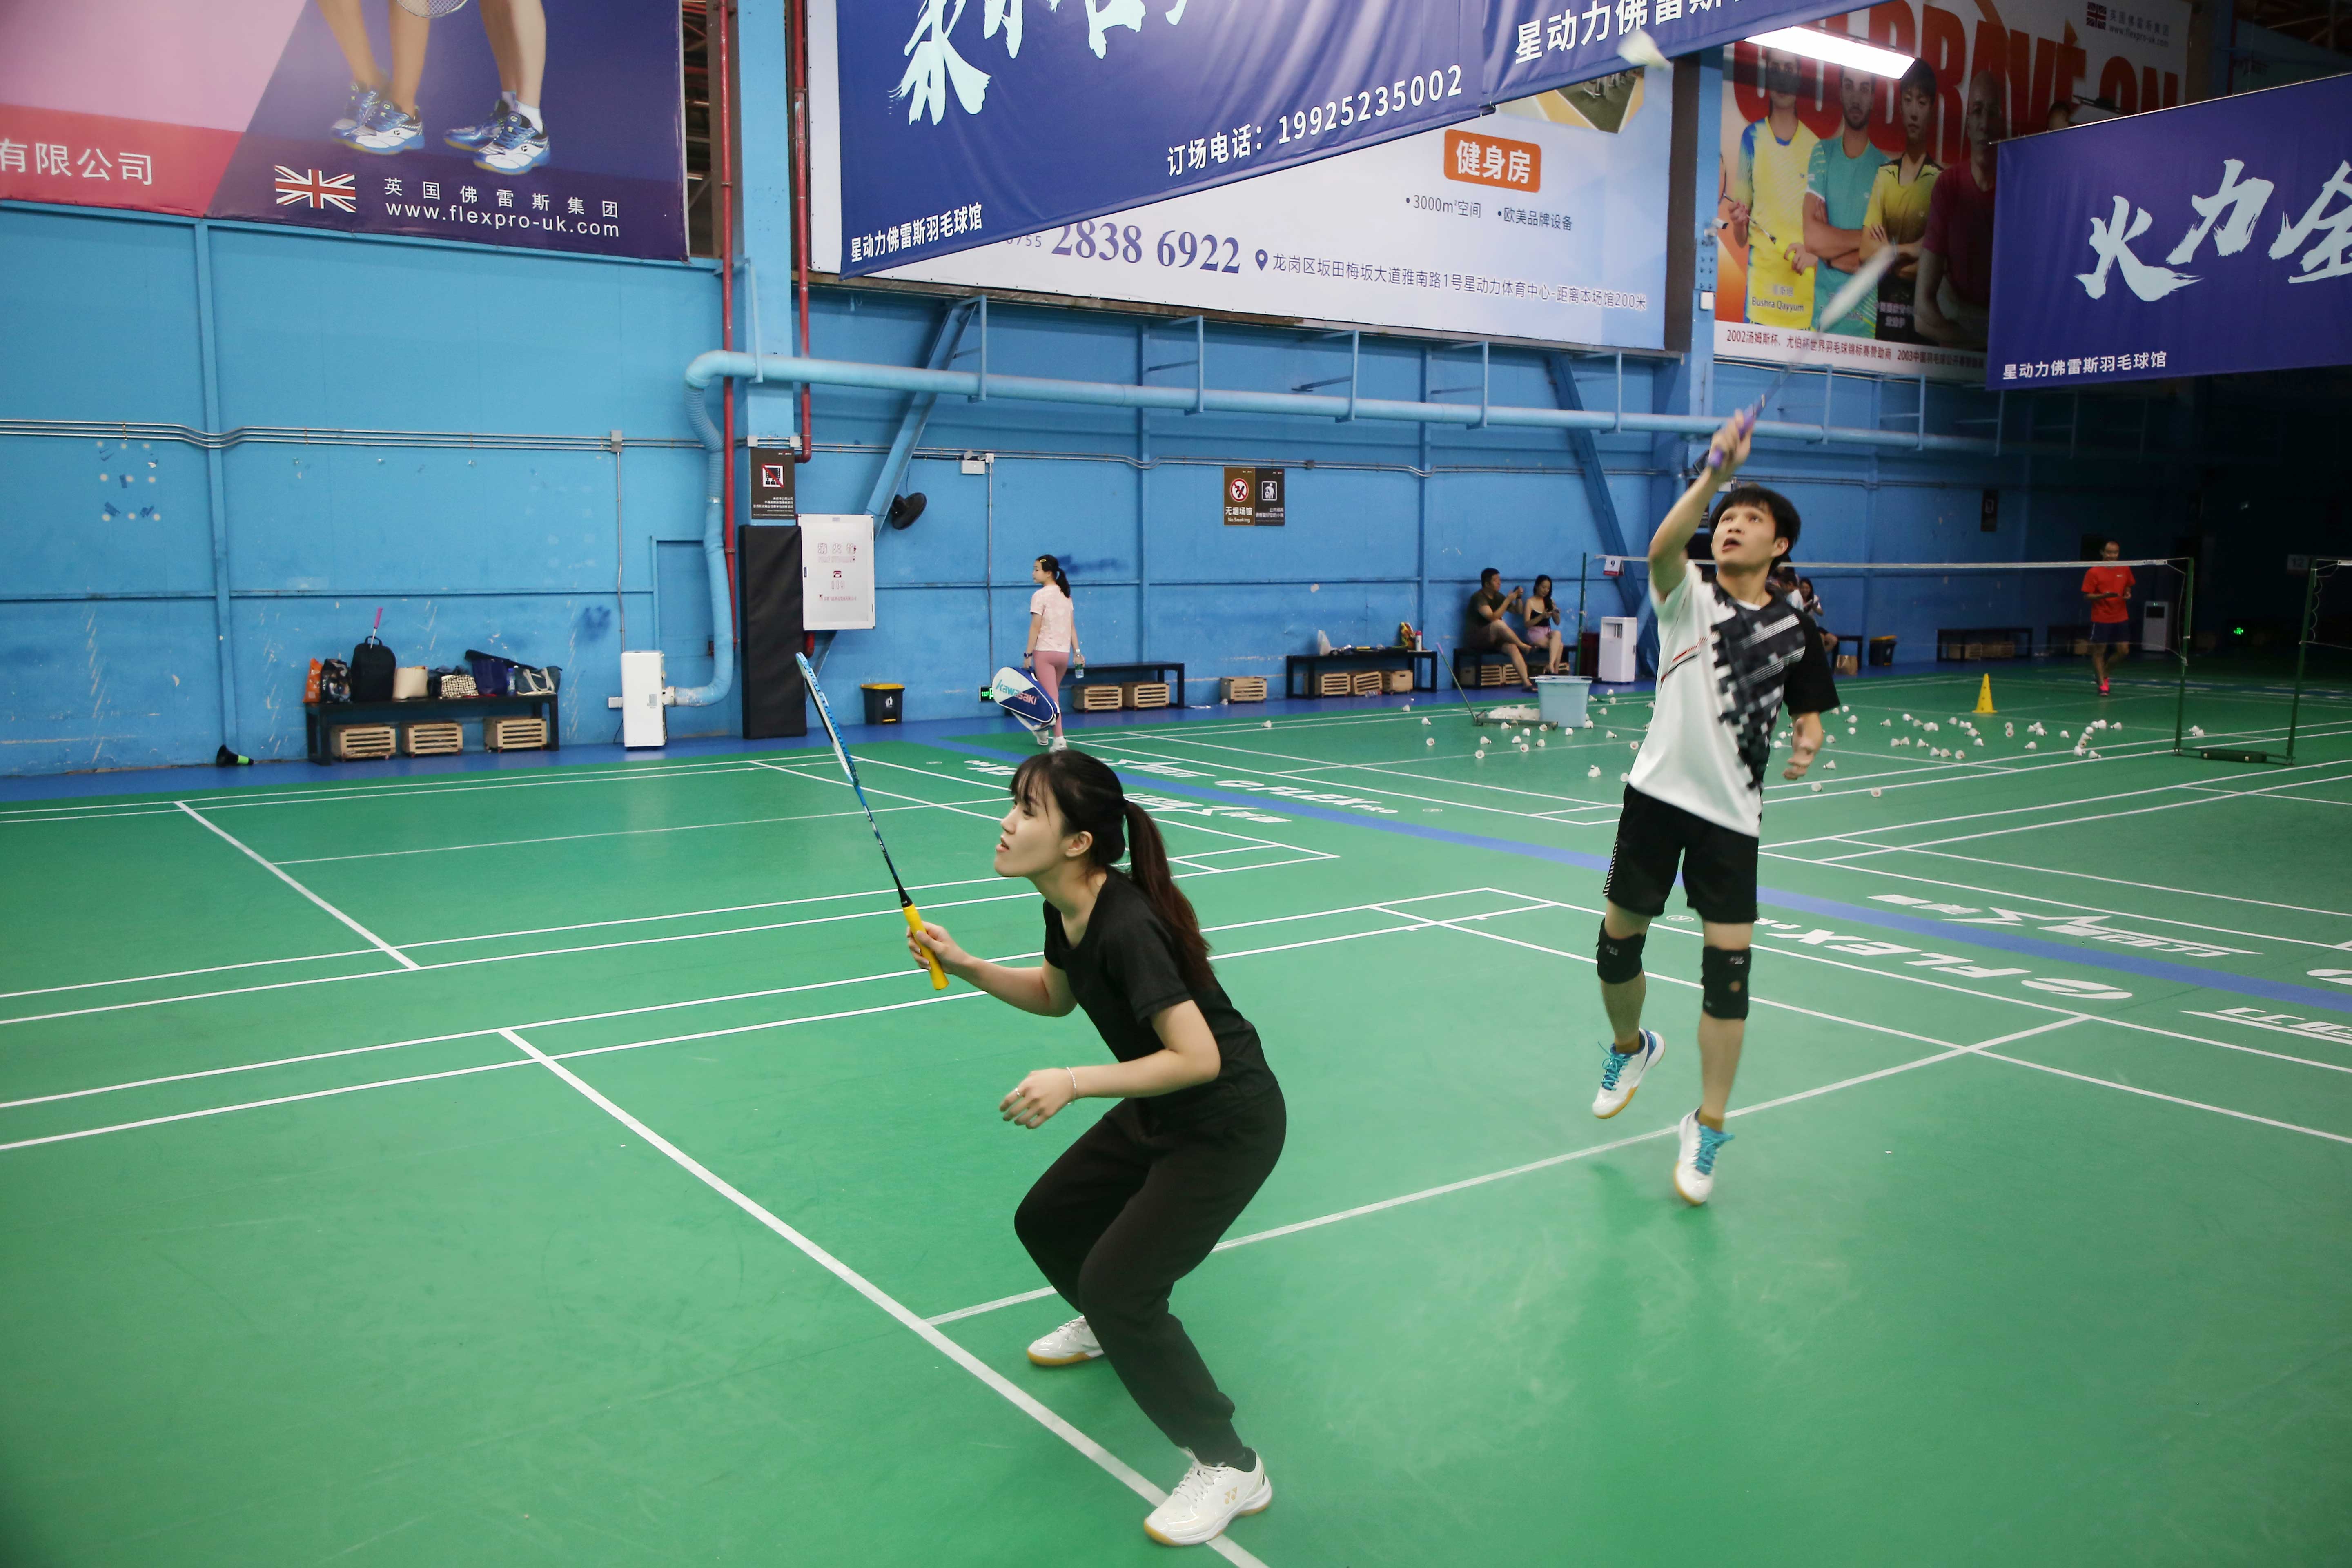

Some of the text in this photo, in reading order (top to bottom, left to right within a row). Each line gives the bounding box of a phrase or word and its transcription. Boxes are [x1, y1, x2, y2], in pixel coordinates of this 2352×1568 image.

[0, 138, 154, 186] 有限公司
[1456, 139, 1531, 185] 健身房
[384, 177, 619, 219] 英国佛雷斯集团
[385, 202, 619, 237] www.flexpro-uk.com
[851, 201, 983, 263] 星动力佛雷斯羽毛球馆
[1503, 207, 1572, 231] 欧美品牌设备
[1051, 219, 1143, 263] 2838
[1157, 230, 1241, 274] 6922
[1751, 296, 1804, 313] Bushra Qayyum
[2002, 351, 2167, 380] 星动力佛雷斯羽毛球馆
[1610, 559, 1615, 568] 9
